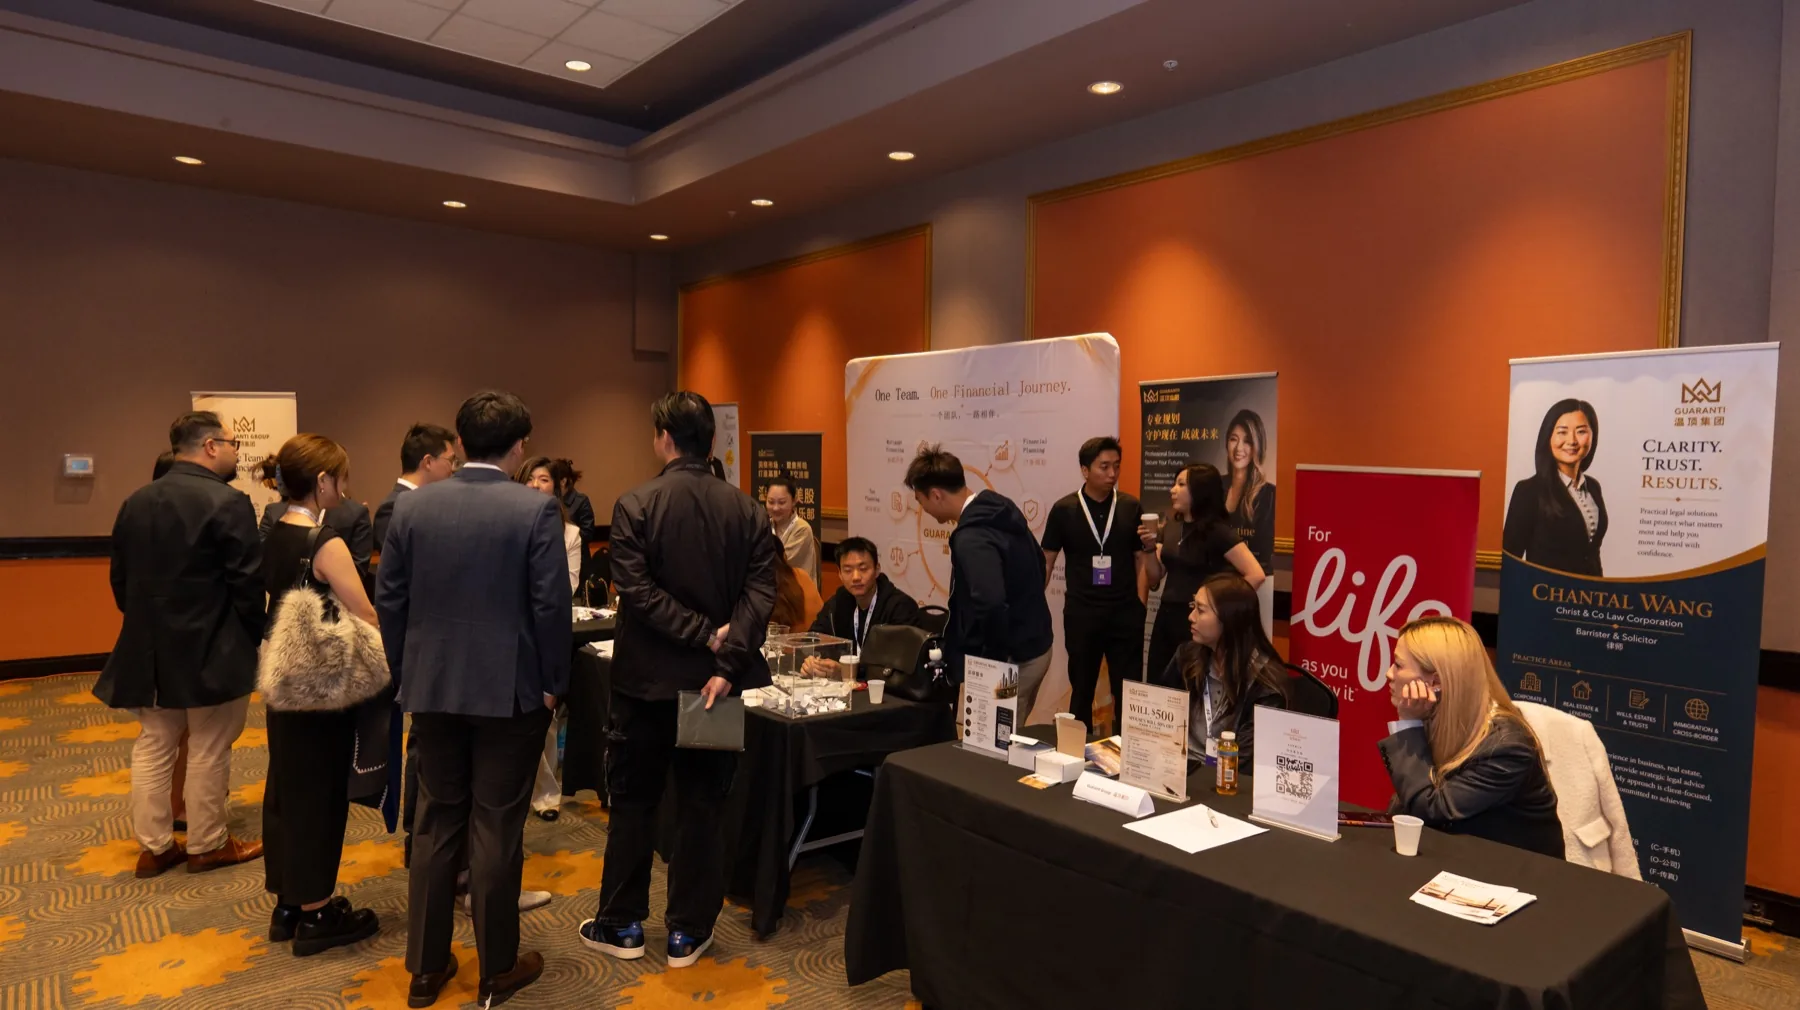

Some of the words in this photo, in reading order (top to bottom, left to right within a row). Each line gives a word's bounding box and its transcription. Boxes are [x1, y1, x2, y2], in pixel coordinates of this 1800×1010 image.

[875, 389, 890, 401] One
[896, 388, 919, 400] Team.
[930, 386, 948, 399] One
[954, 382, 1010, 398] Financial
[1018, 380, 1071, 397] Journey.
[1674, 407, 1726, 415] GUARANTI
[1674, 416, 1725, 426] 温顶集团
[1643, 439, 1722, 453] CLARITY.
[1642, 457, 1702, 471] TRUST.
[1642, 474, 1722, 490] RESULTS.
[924, 528, 950, 539] GUARA
[1308, 526, 1331, 542] For
[1670, 530, 1685, 538] help
[1637, 550, 1674, 558] confidence.
[1532, 583, 1634, 610] CHANTAL
[1640, 593, 1713, 618] WANG
[1556, 606, 1580, 616] Christ
[1592, 610, 1604, 619] Co
[1607, 612, 1624, 621] Law
[1627, 614, 1683, 628] Corporation
[1576, 627, 1610, 639] Barrister
[1622, 633, 1658, 645] Solicitor
[1513, 653, 1546, 664] PRACTICE
[1548, 658, 1572, 667] AREAS
[1302, 659, 1317, 672] as
[1320, 662, 1347, 679] you
[1576, 703, 1594, 711] ESTATE
[1151, 708, 1174, 722] $500
[1634, 715, 1656, 723] ESTATES
[1628, 721, 1648, 729] TRUSTS
[1673, 721, 1713, 733] IMMIGRATION
[1673, 729, 1719, 742] CROSS-BORDER
[1638, 758, 1666, 770] business,
[1681, 768, 1702, 778] estate,
[1615, 765, 1638, 774] provide
[1640, 770, 1665, 780] strategic
[1666, 775, 1681, 785] legal
[1683, 780, 1705, 789] advice
[1627, 779, 1655, 789] approach
[1659, 796, 1691, 809] achieving
